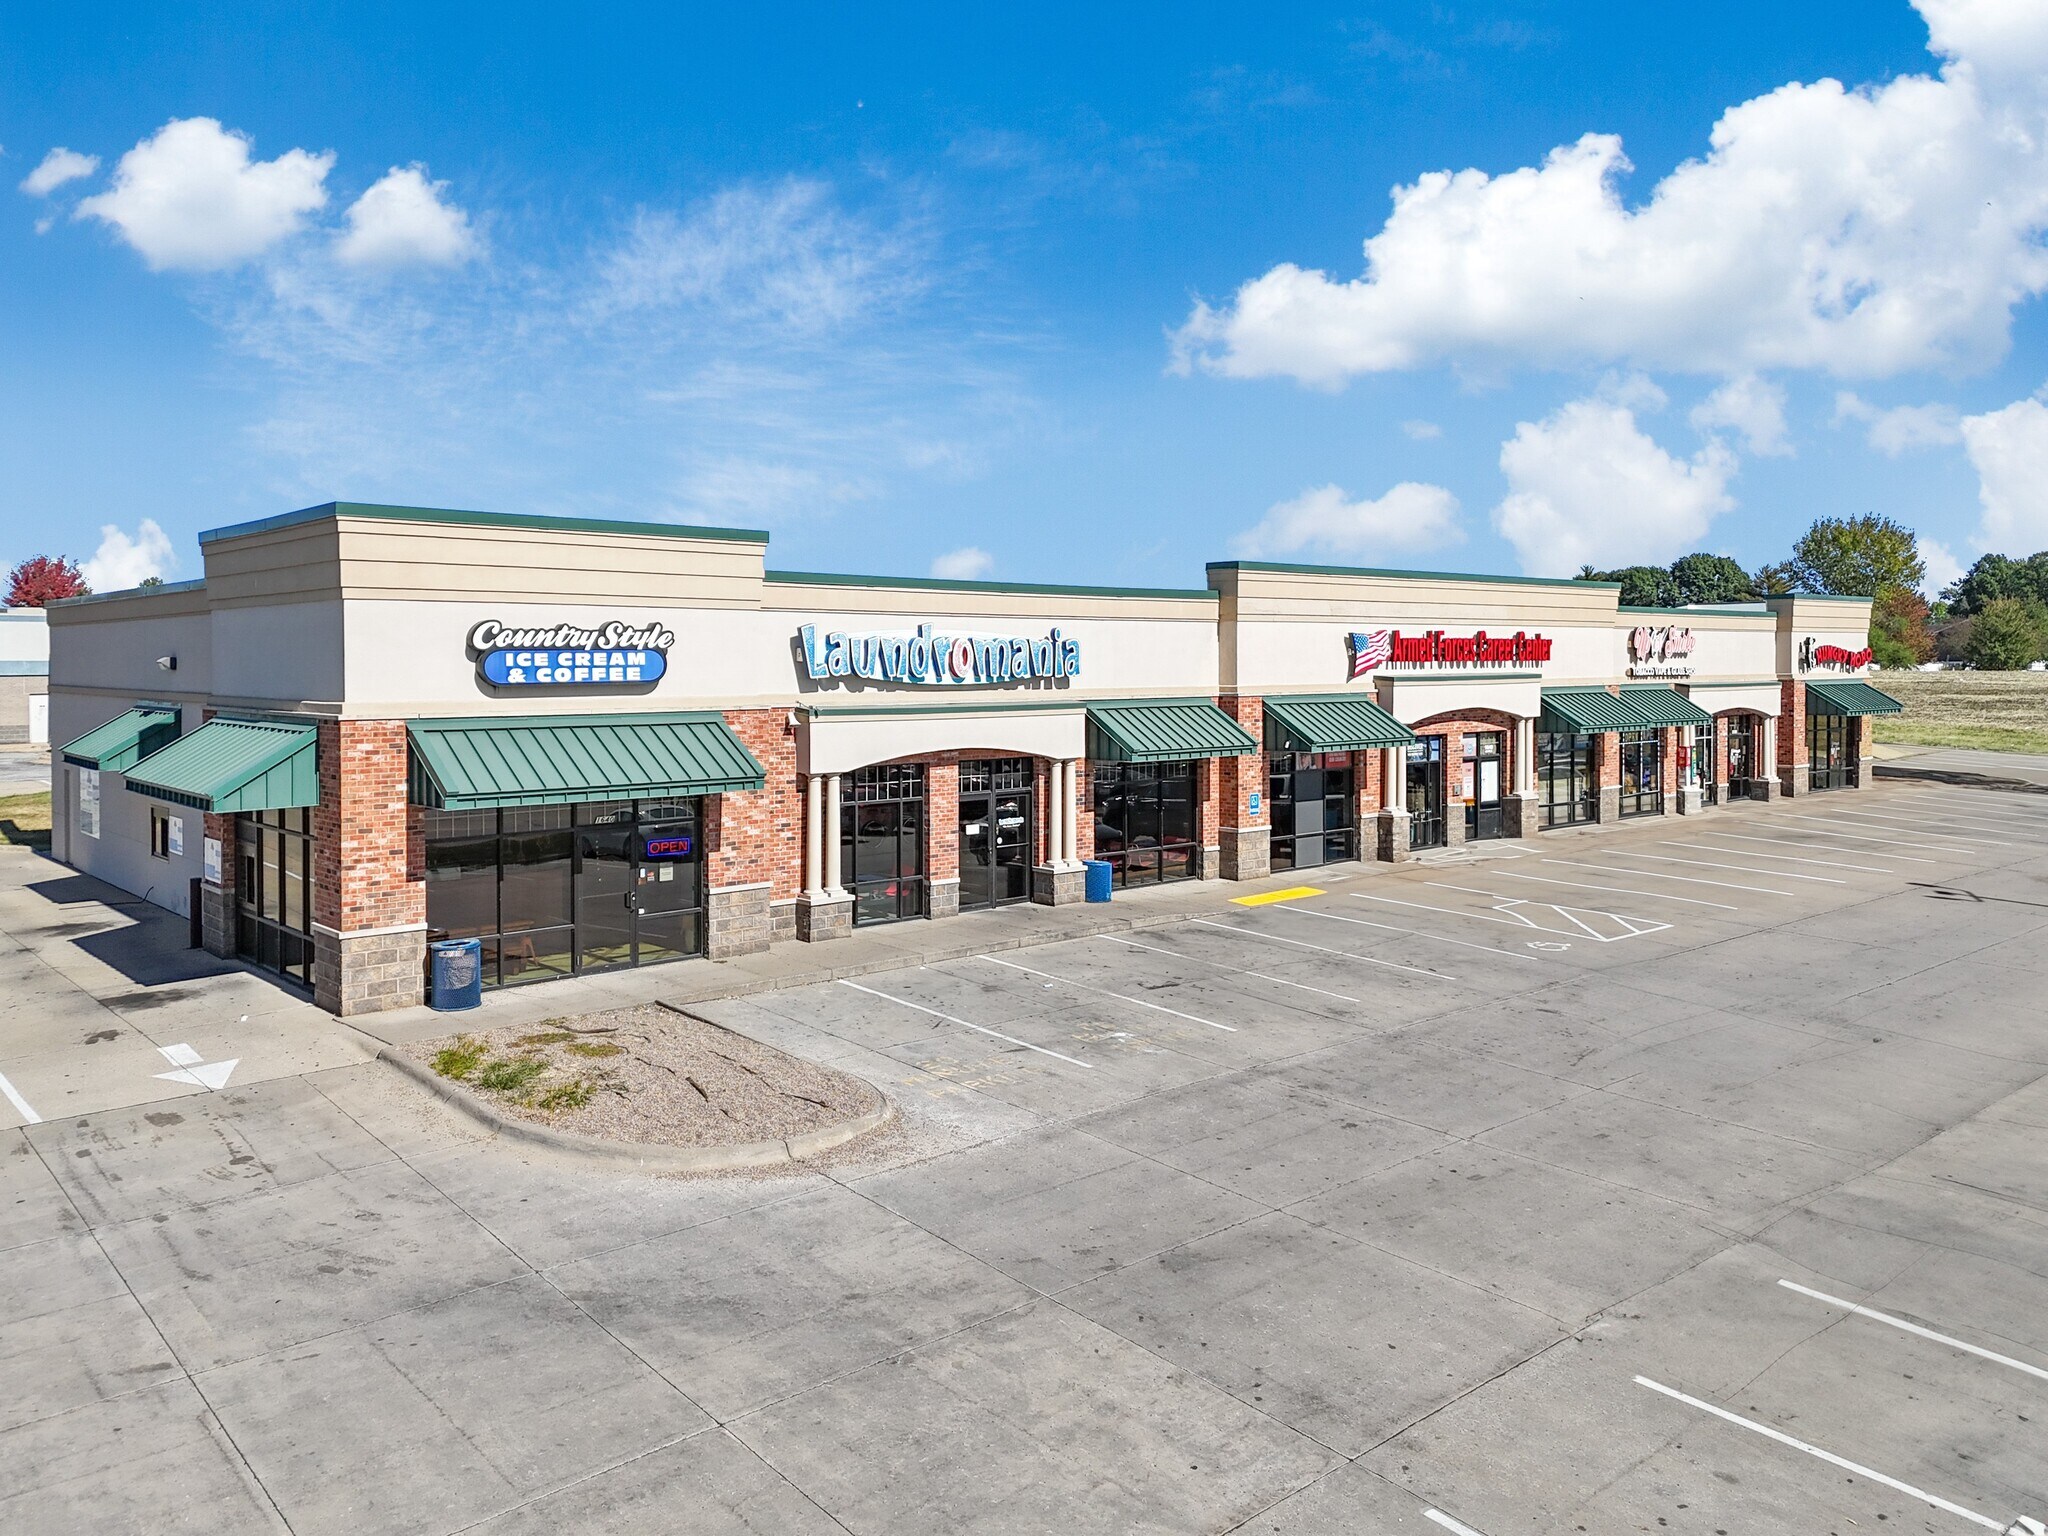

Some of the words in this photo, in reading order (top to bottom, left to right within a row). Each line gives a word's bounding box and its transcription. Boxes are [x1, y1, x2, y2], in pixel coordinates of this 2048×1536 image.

[473, 621, 599, 650] Country
[598, 621, 674, 650] Style
[1392, 630, 1434, 661] Armed
[1437, 630, 1476, 661] Forces
[1479, 630, 1516, 661] Career
[1518, 631, 1552, 661] Center
[505, 652, 549, 667] ICE
[558, 652, 646, 667] CREAM
[800, 622, 1081, 679] Laundromania
[1816, 645, 1848, 664] HUNGRY
[1850, 647, 1872, 669] HOBO
[507, 668, 526, 683] &
[536, 667, 641, 682] COFFEE
[595, 816, 616, 824] 1640
[650, 841, 687, 854] OPEN
